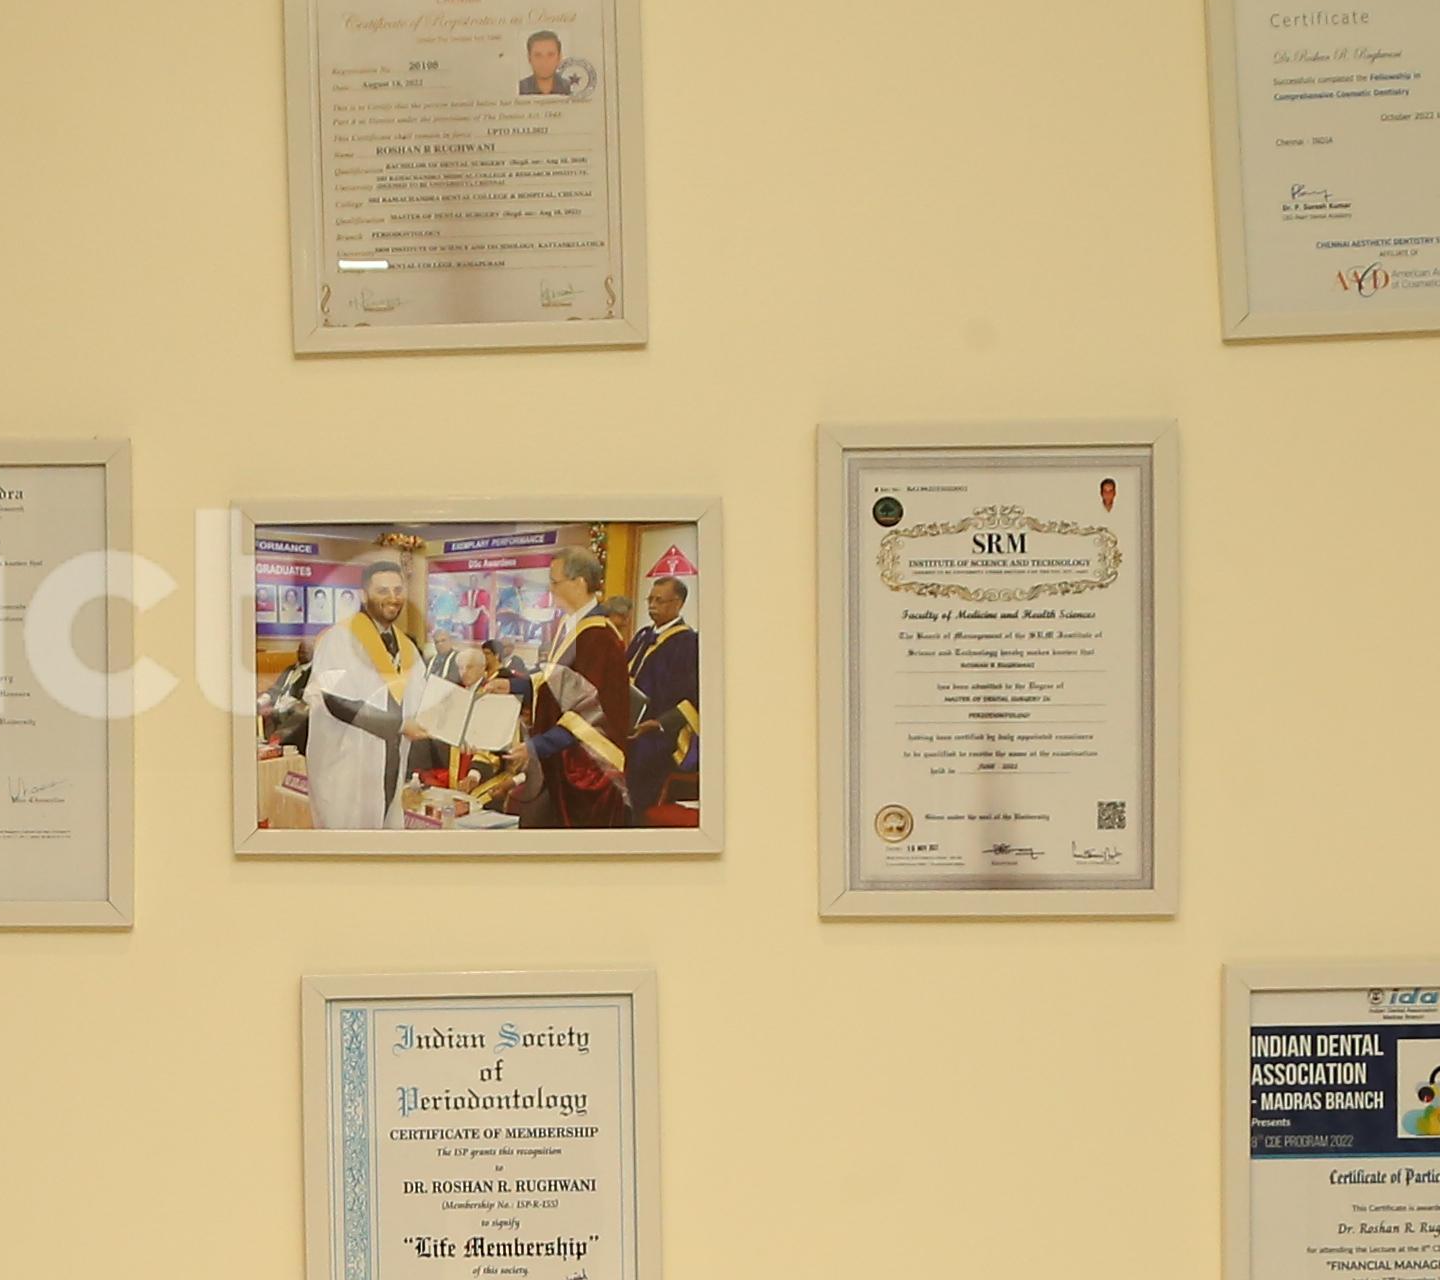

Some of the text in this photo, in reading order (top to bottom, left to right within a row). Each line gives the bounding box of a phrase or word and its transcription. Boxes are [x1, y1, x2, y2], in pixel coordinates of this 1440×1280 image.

[1270, 10, 1369, 28] Certificate
[971, 533, 1027, 554] SRM
[909, 559, 956, 567] INSTITUTE
[958, 559, 969, 567] OF
[971, 559, 1006, 567] SCIENCE
[1031, 558, 1091, 567] TECHNOLOGY
[393, 1022, 590, 1055] Indian Society
[1251, 1034, 1383, 1057] INDIAN DENTAL
[480, 1059, 504, 1083] of
[1251, 1063, 1367, 1086] ASSOCIATION
[398, 1087, 588, 1117] Periodontology
[1261, 1091, 1384, 1110] MADRAS BRANCH
[1251, 1118, 1290, 1127] Presents
[390, 1127, 599, 1141] CERTIFICATE OF MEMBERSHIP
[403, 1179, 596, 1194] DR. ROSHAN R. RUGHWANI
[1329, 1169, 1387, 1186] Certificate
[1390, 1169, 1402, 1185] of
